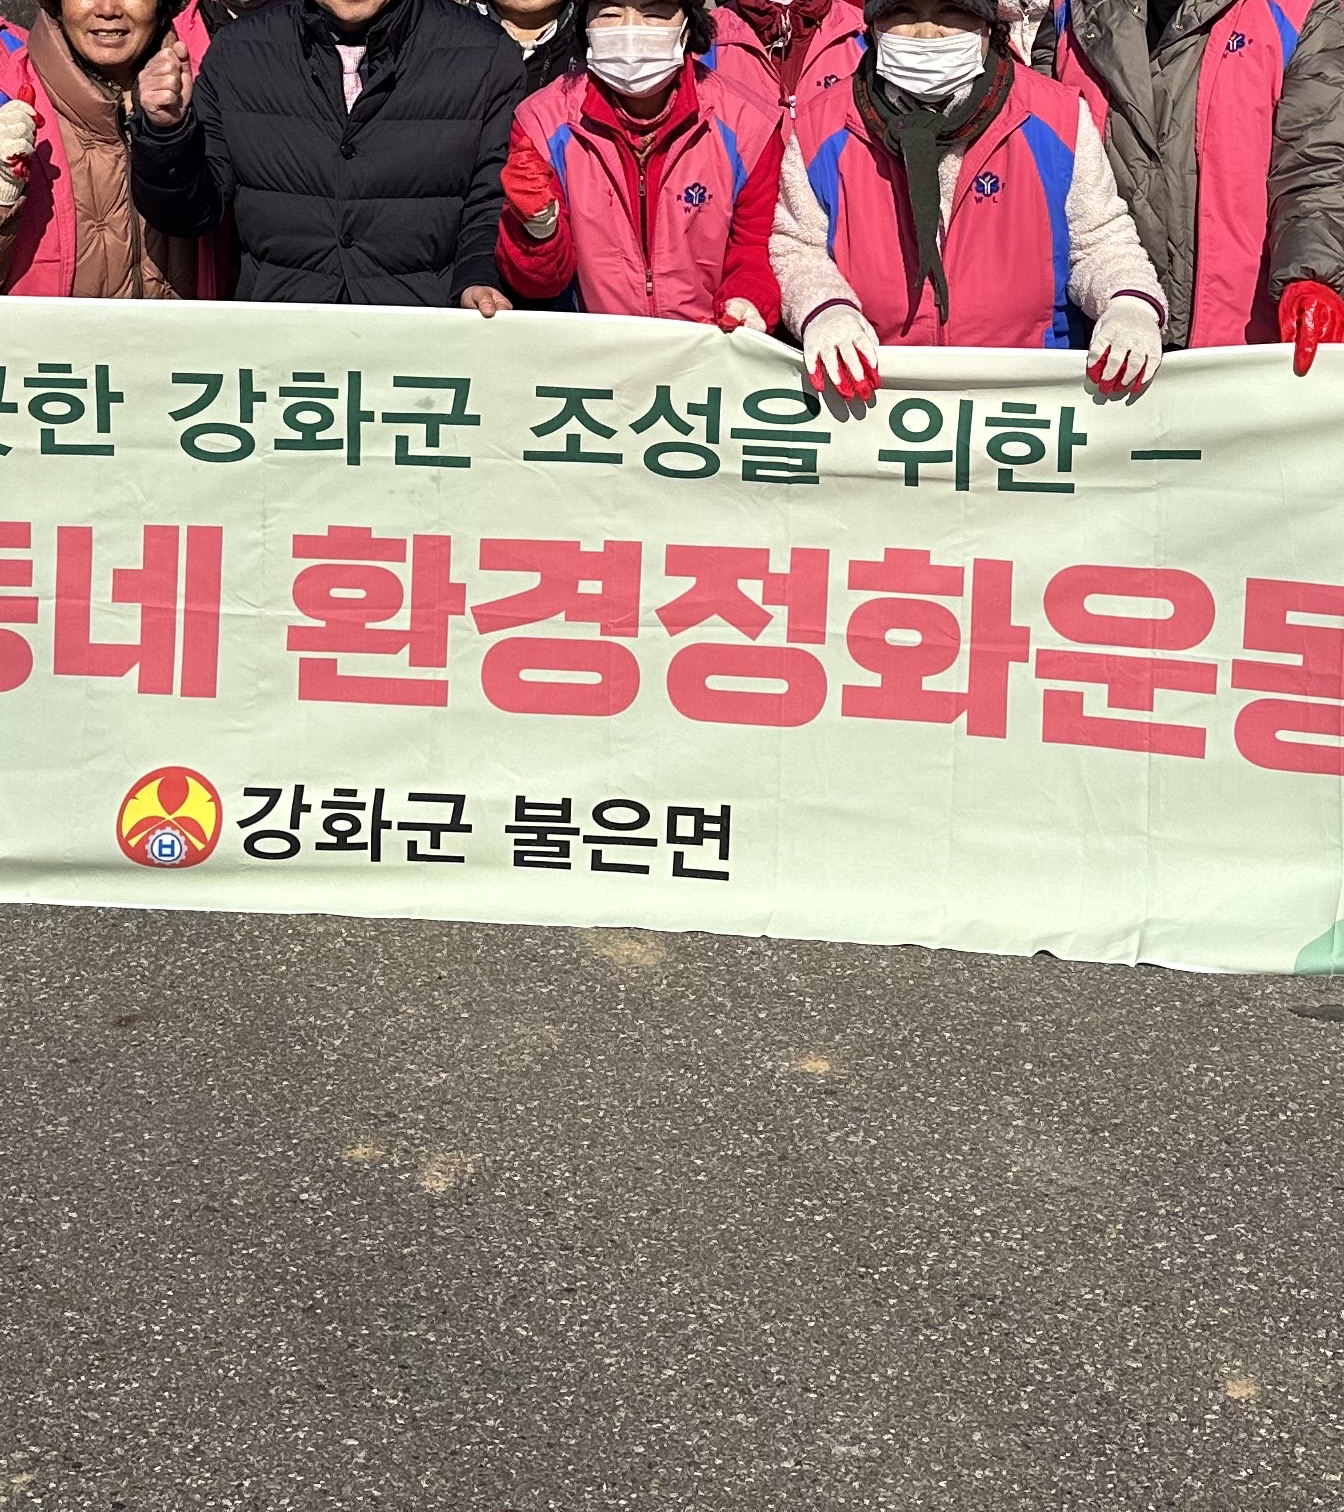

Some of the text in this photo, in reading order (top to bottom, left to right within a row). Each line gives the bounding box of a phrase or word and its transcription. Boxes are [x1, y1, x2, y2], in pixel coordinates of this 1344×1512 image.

[167, 368, 481, 469] 강화군
[522, 384, 832, 486] 조성을
[877, 397, 1088, 494] 위한
[236, 783, 731, 882] 강화군 불은면
